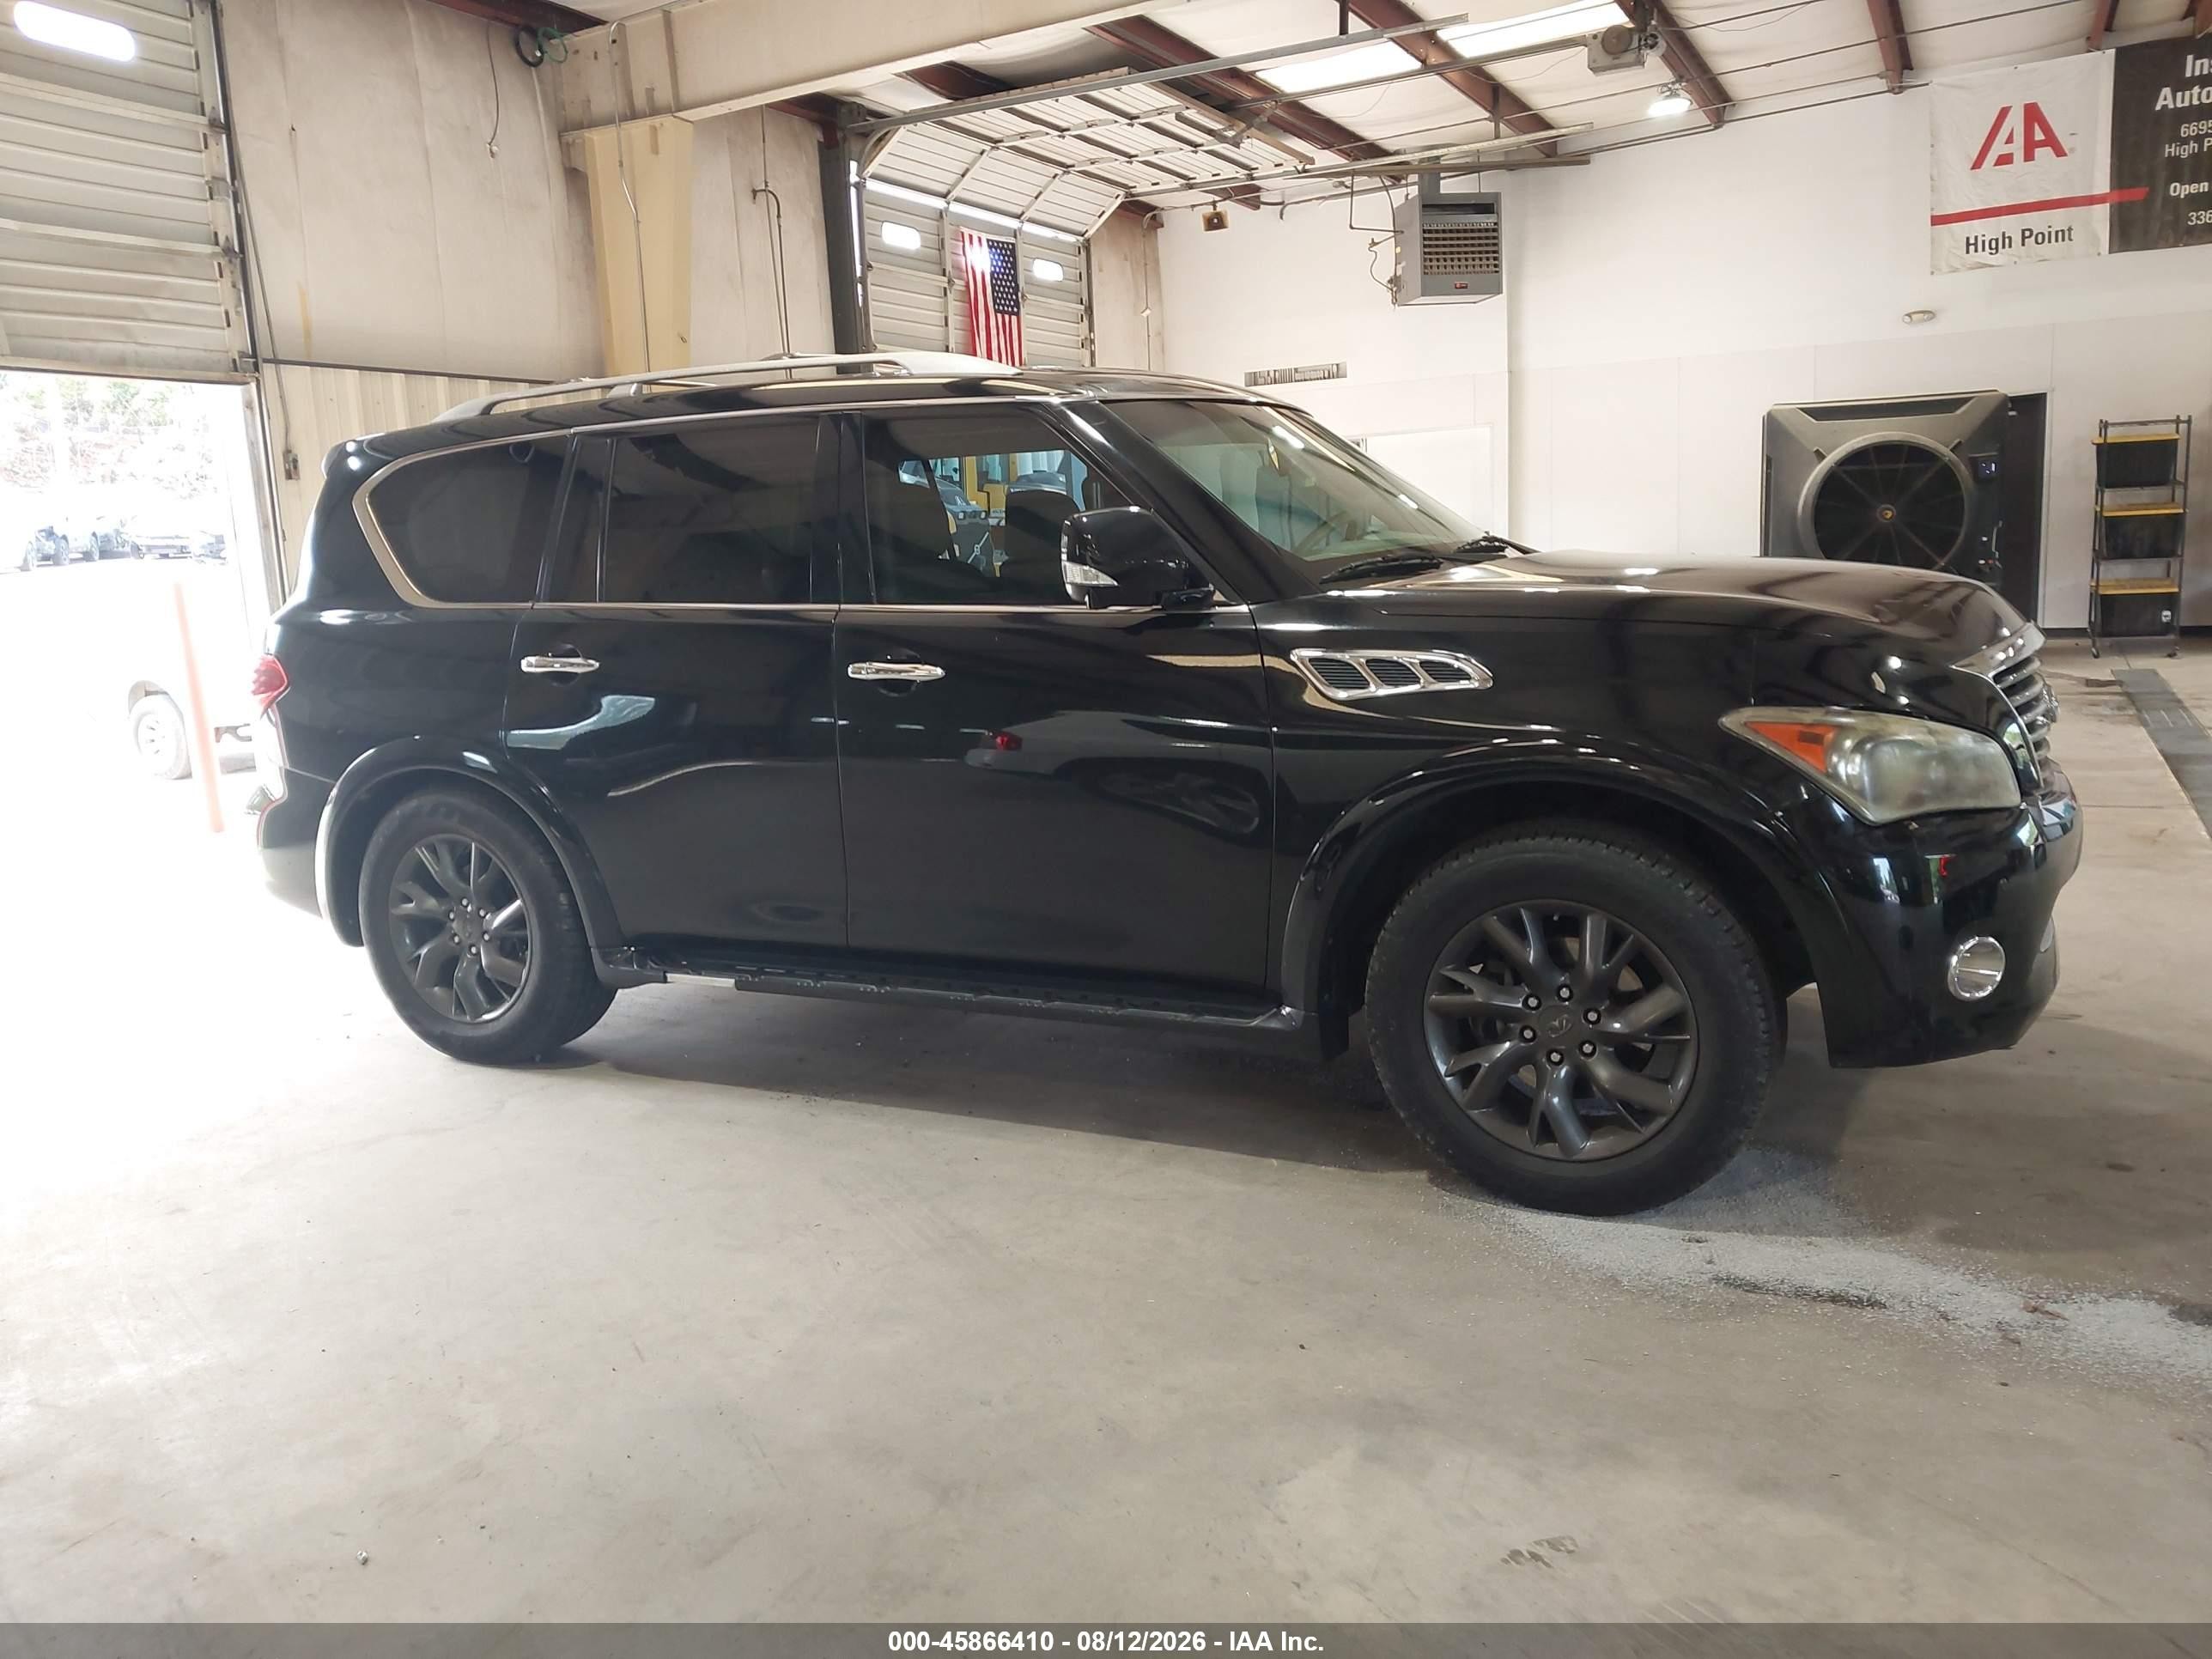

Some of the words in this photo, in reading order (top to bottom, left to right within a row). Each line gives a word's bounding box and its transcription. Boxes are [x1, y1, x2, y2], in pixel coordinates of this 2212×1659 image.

[2185, 53, 2212, 78] In
[2154, 85, 2212, 111] Auto
[2164, 140, 2198, 159] High
[2169, 181, 2209, 199] Open
[1965, 230, 2013, 256] High
[2021, 224, 2075, 247] Point
